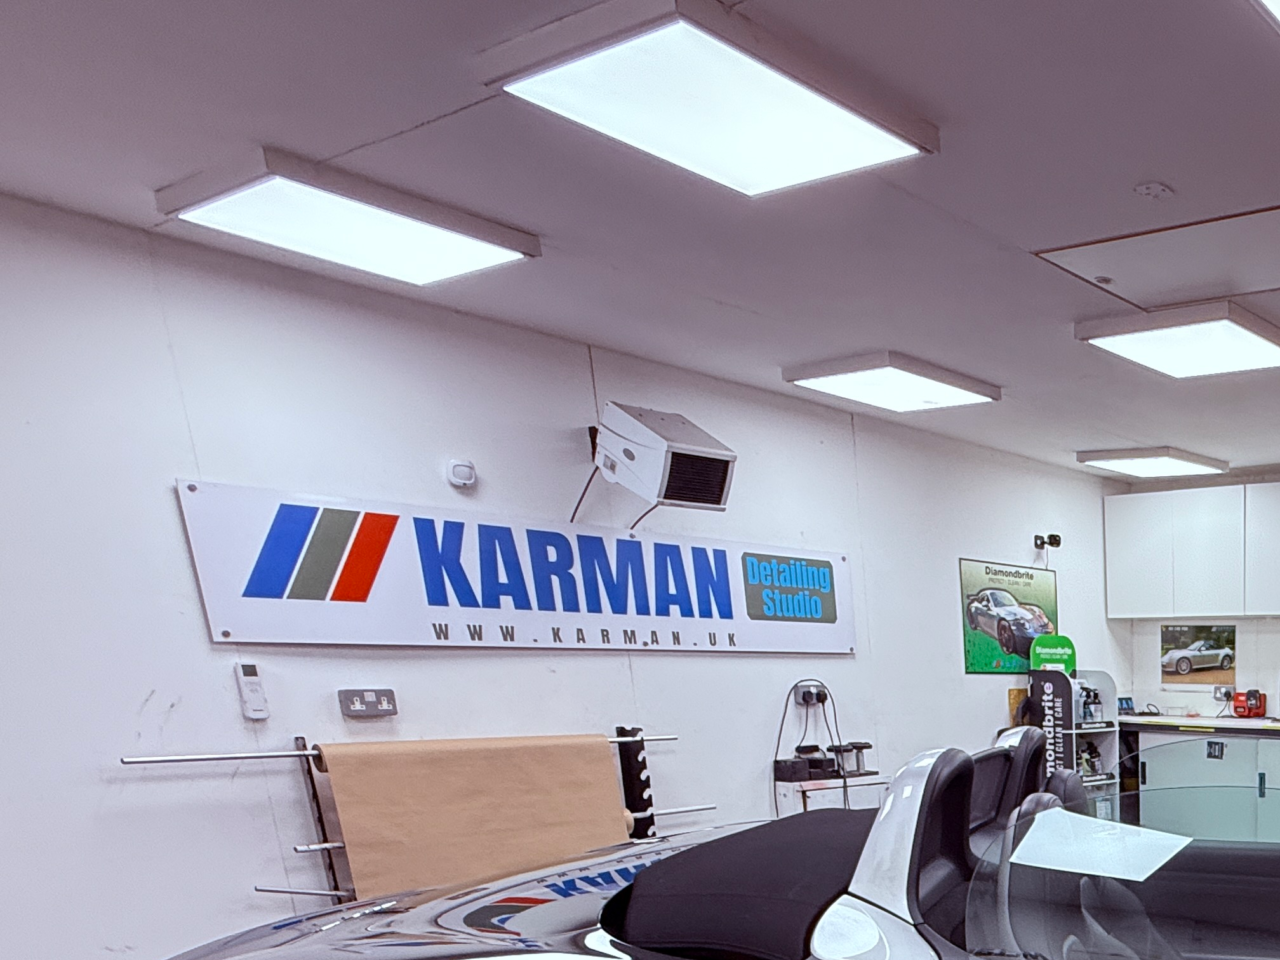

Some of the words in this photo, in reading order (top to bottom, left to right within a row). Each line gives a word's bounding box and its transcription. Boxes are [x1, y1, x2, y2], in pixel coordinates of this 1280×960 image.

[413, 517, 734, 620] KARMAN
[745, 556, 831, 593] Detailing
[985, 566, 1034, 580] Diamondbrite
[761, 588, 823, 619] Studio
[1054, 698, 1062, 717] CARE
[1042, 682, 1055, 777] mondbrite
[1055, 727, 1063, 752] CLEAN
